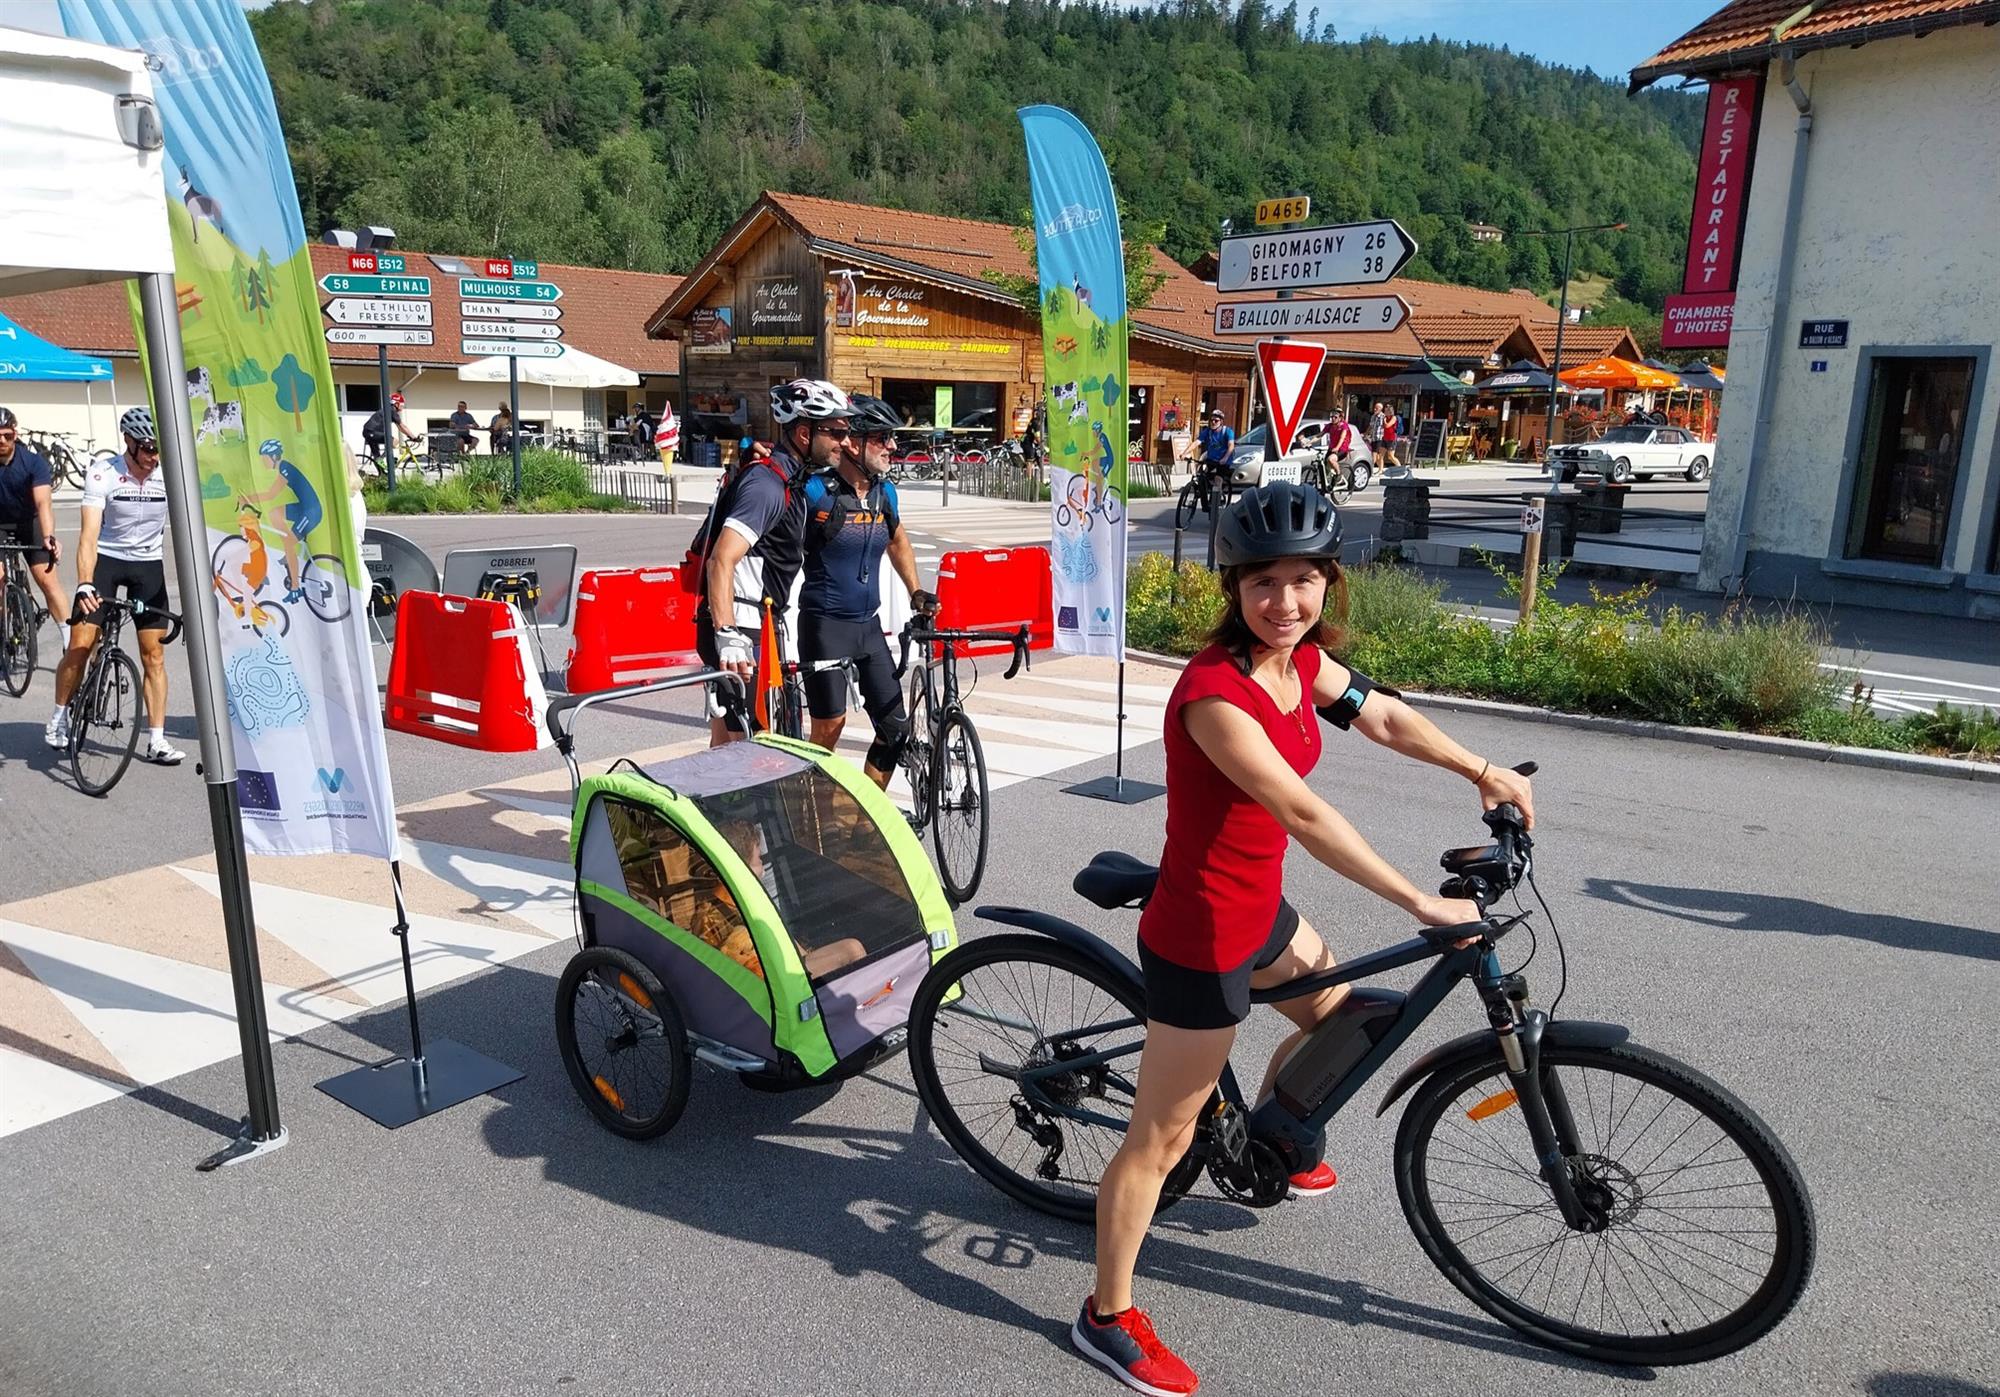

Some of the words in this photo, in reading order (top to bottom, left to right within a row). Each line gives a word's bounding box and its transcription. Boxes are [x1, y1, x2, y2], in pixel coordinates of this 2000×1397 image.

[1703, 87, 1740, 284] RESTAURANT
[1252, 235, 1346, 260] GIROMAGNY
[1364, 232, 1387, 251] 26
[352, 258, 374, 269] N66
[378, 259, 403, 270] E512
[489, 263, 510, 275] N66
[513, 264, 536, 276] E512
[1250, 260, 1323, 283] BELFORT
[1363, 256, 1384, 274] 38
[333, 279, 350, 290] 58
[381, 279, 427, 292] ÉPINAL
[464, 283, 522, 296] MULHOUSE
[536, 287, 551, 297] 54
[755, 284, 769, 297] Au
[770, 283, 799, 298] Chalet
[863, 284, 882, 298] Au
[885, 285, 924, 301] Chalet
[339, 302, 346, 310] 6
[363, 303, 376, 311] LE
[382, 304, 428, 313] THILLOT
[465, 305, 501, 315] THANN
[542, 308, 554, 317] 30
[765, 300, 776, 310] de
[778, 299, 788, 309] la
[877, 300, 893, 312] de
[896, 301, 910, 313] la
[340, 312, 346, 320] 4
[359, 313, 400, 321] FRESSE
[751, 310, 803, 326] Gourmandise
[856, 309, 930, 327] Gourmandise
[1238, 309, 1290, 327] BALLON
[1381, 306, 1393, 323] 9
[465, 325, 515, 334] BUSSANG
[1814, 324, 1835, 333] RUE
[334, 331, 355, 341] 600
[848, 336, 878, 348] PAINS
[883, 339, 951, 352] VIENNOISERIES
[959, 343, 1011, 355] SANDWICHS
[1289, 466, 1297, 476] LE
[490, 557, 536, 568] CD88REM
